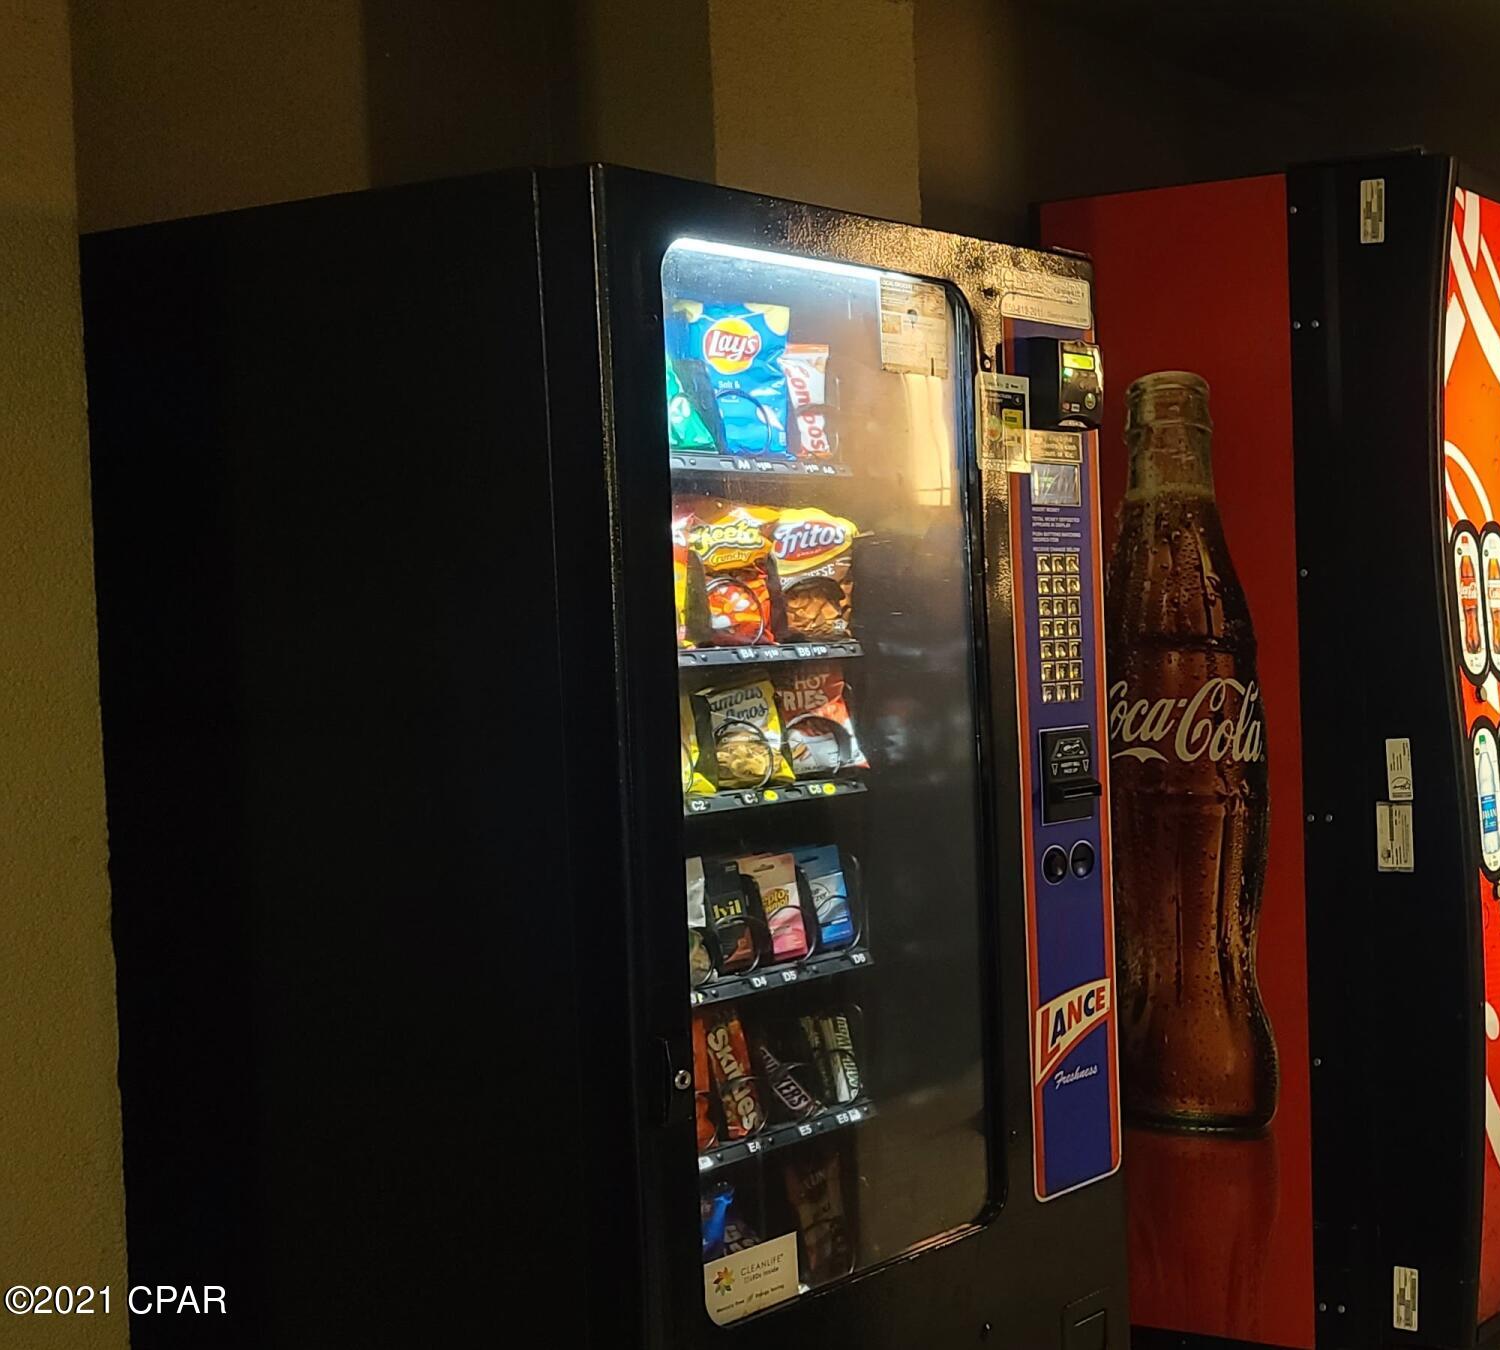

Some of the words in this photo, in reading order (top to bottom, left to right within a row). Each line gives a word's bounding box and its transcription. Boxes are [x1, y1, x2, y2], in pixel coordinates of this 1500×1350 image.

[773, 521, 847, 560] Fritos
[710, 551, 752, 567] Crunchy
[794, 674, 830, 690] HOT
[709, 688, 763, 712] amous
[776, 689, 829, 711] RIES
[753, 977, 767, 988] D4
[783, 970, 797, 982] D5
[1041, 985, 1106, 1074] LANCE
[707, 1026, 758, 1131] Skitles
[1054, 1064, 1099, 1090] Freshness
[748, 1142, 761, 1152] E4
[740, 1254, 781, 1277] CLEANLIFE
